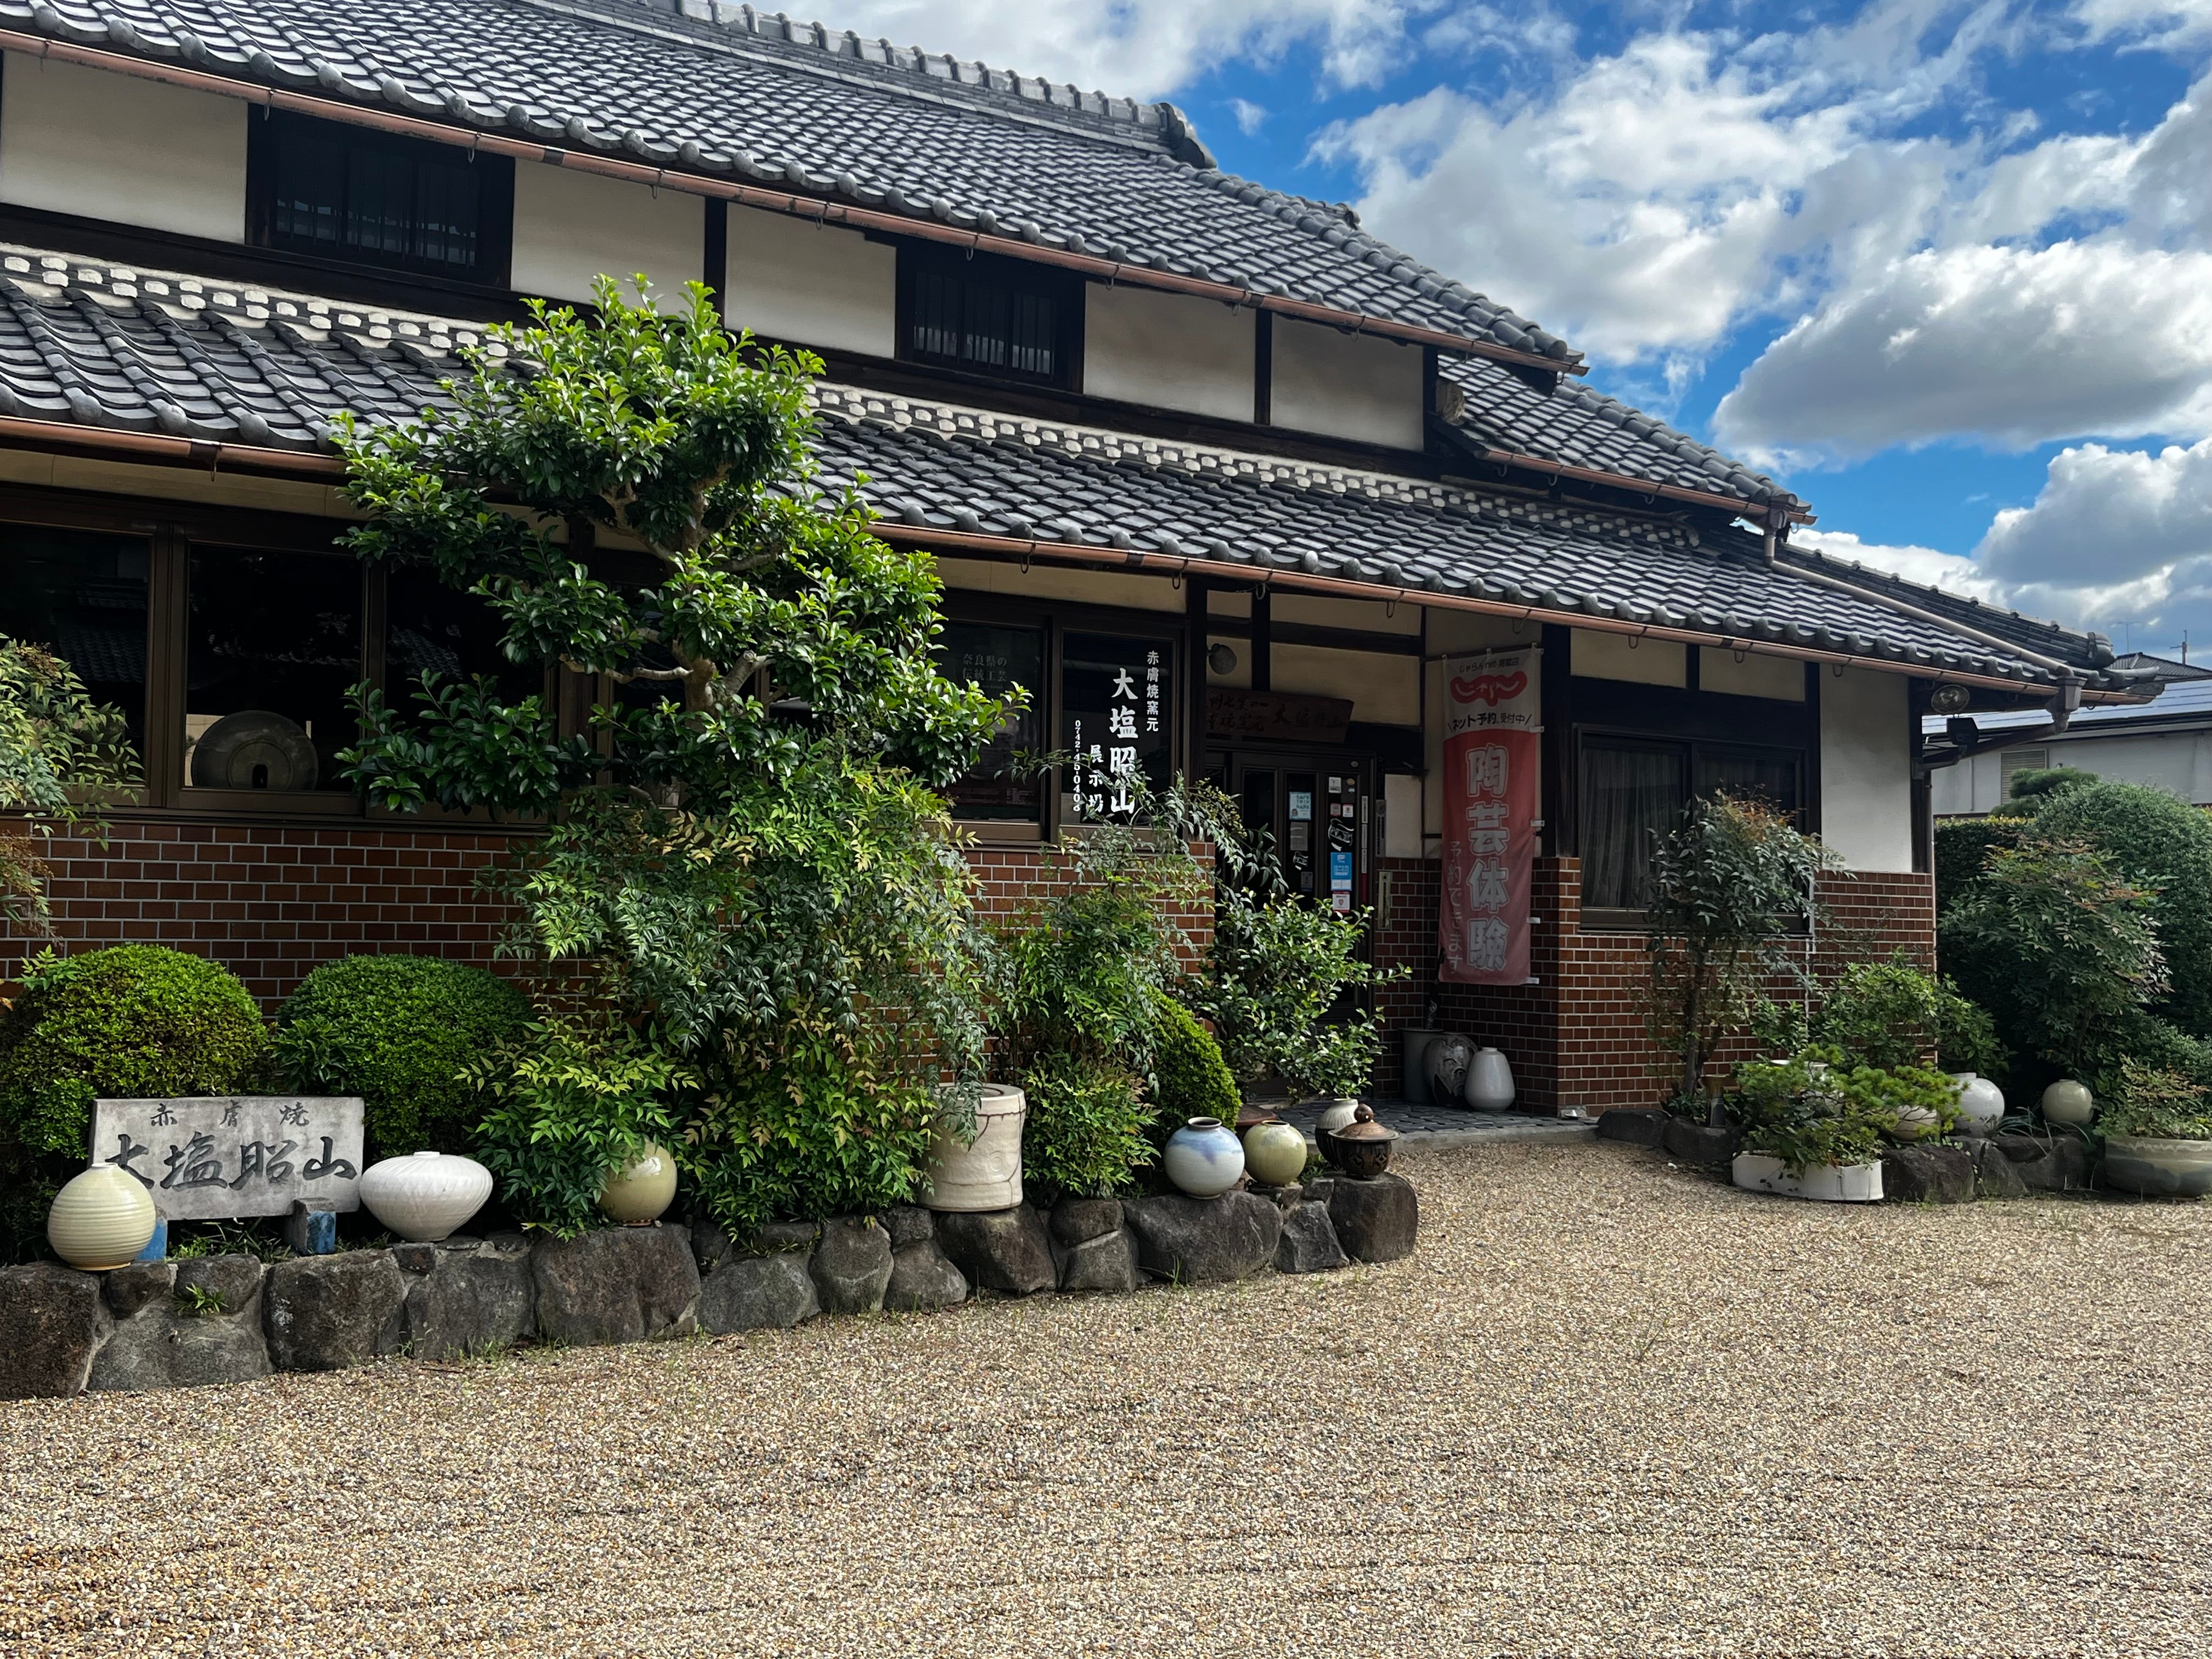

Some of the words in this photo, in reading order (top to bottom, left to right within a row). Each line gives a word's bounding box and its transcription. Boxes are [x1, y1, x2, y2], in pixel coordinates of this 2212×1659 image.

[962, 653, 1007, 668] 奈良県の
[962, 668, 1007, 682] 伝統工芸
[1109, 667, 1139, 815] 大塩昭山
[1465, 743, 1510, 972] 陶芸体験
[1447, 841, 1463, 974] 予約できます
[104, 1131, 358, 1192] 大塩昭山
